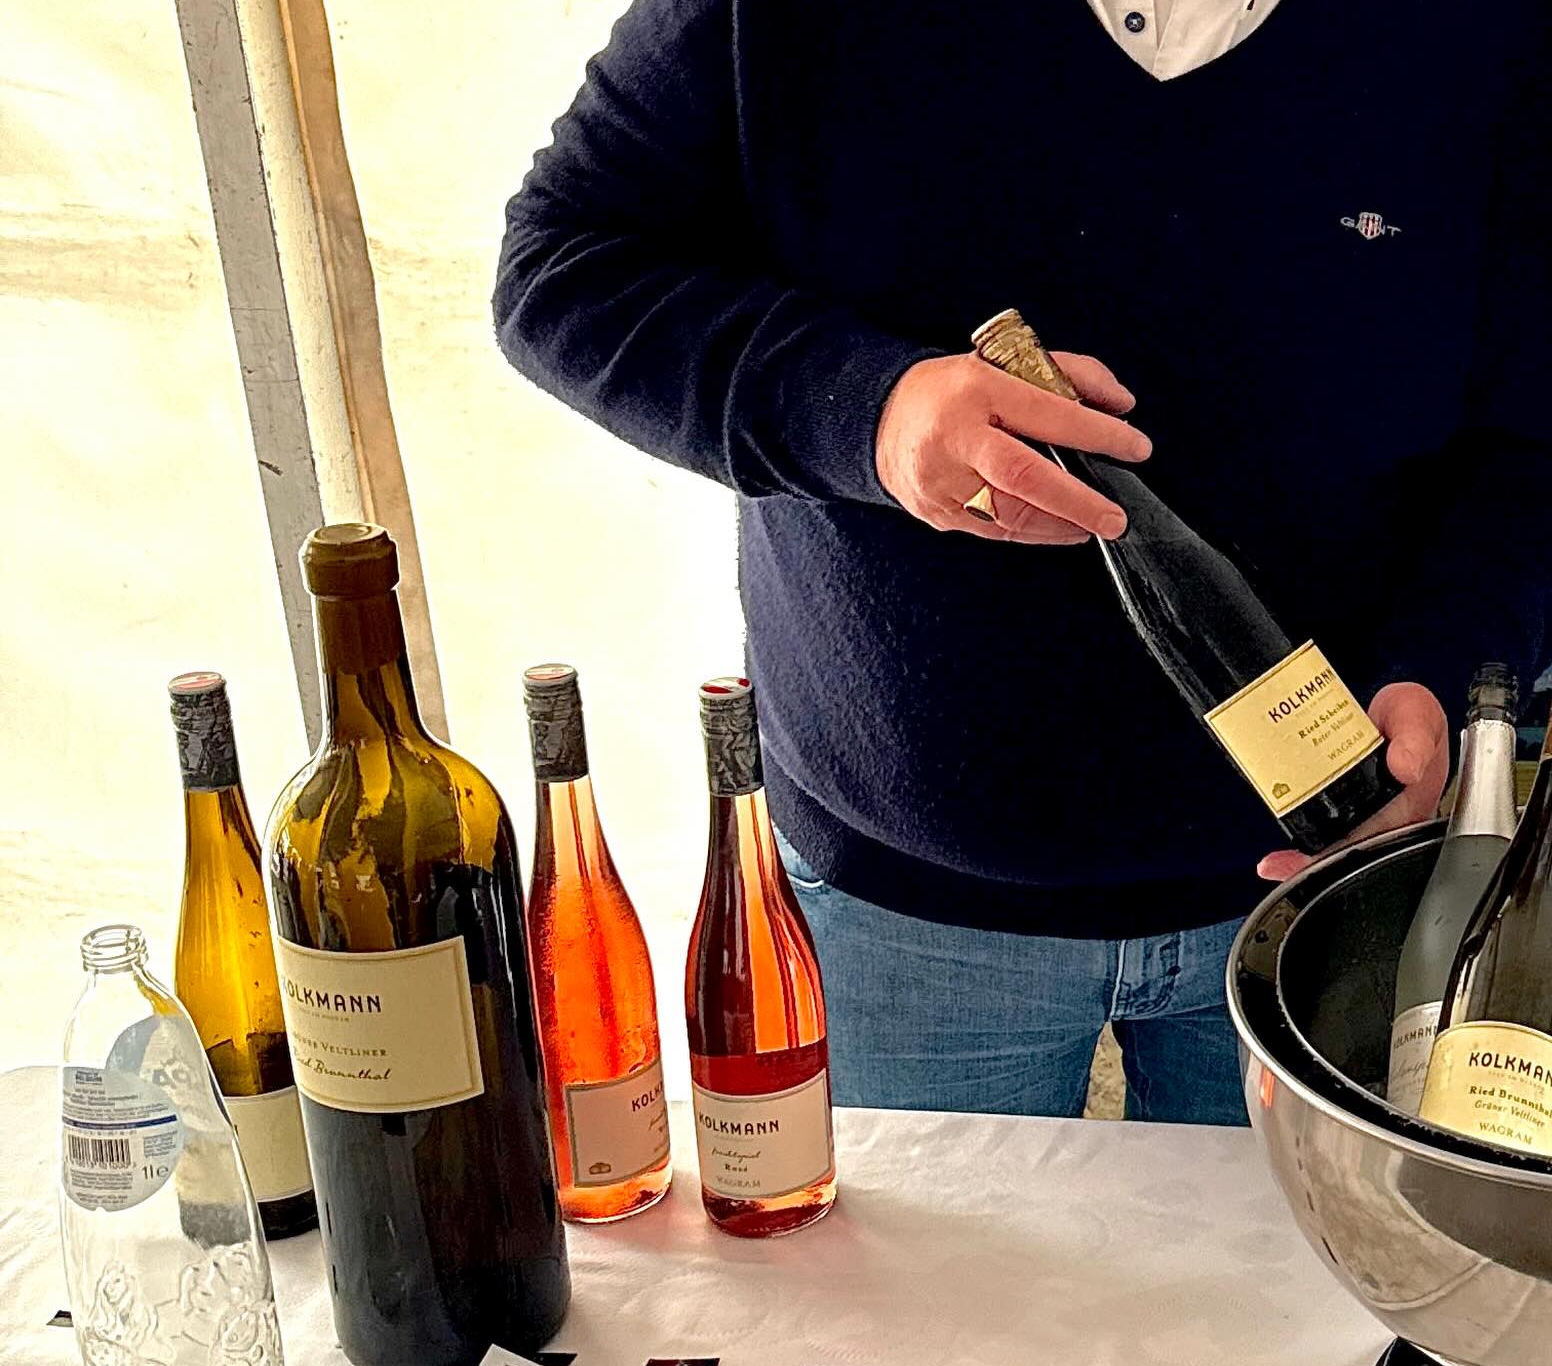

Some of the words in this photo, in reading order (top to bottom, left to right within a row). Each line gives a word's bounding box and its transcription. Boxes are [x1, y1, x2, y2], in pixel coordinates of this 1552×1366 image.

[1267, 666, 1335, 724] KOLKMANN
[1298, 719, 1320, 739] Ried
[1327, 730, 1366, 760] WAGRAM
[321, 1041, 387, 1056] VELTLINER
[1469, 1085, 1496, 1096] Ried
[698, 1113, 780, 1135] KOLKMANN
[1479, 1121, 1533, 1145] WAGRAM
